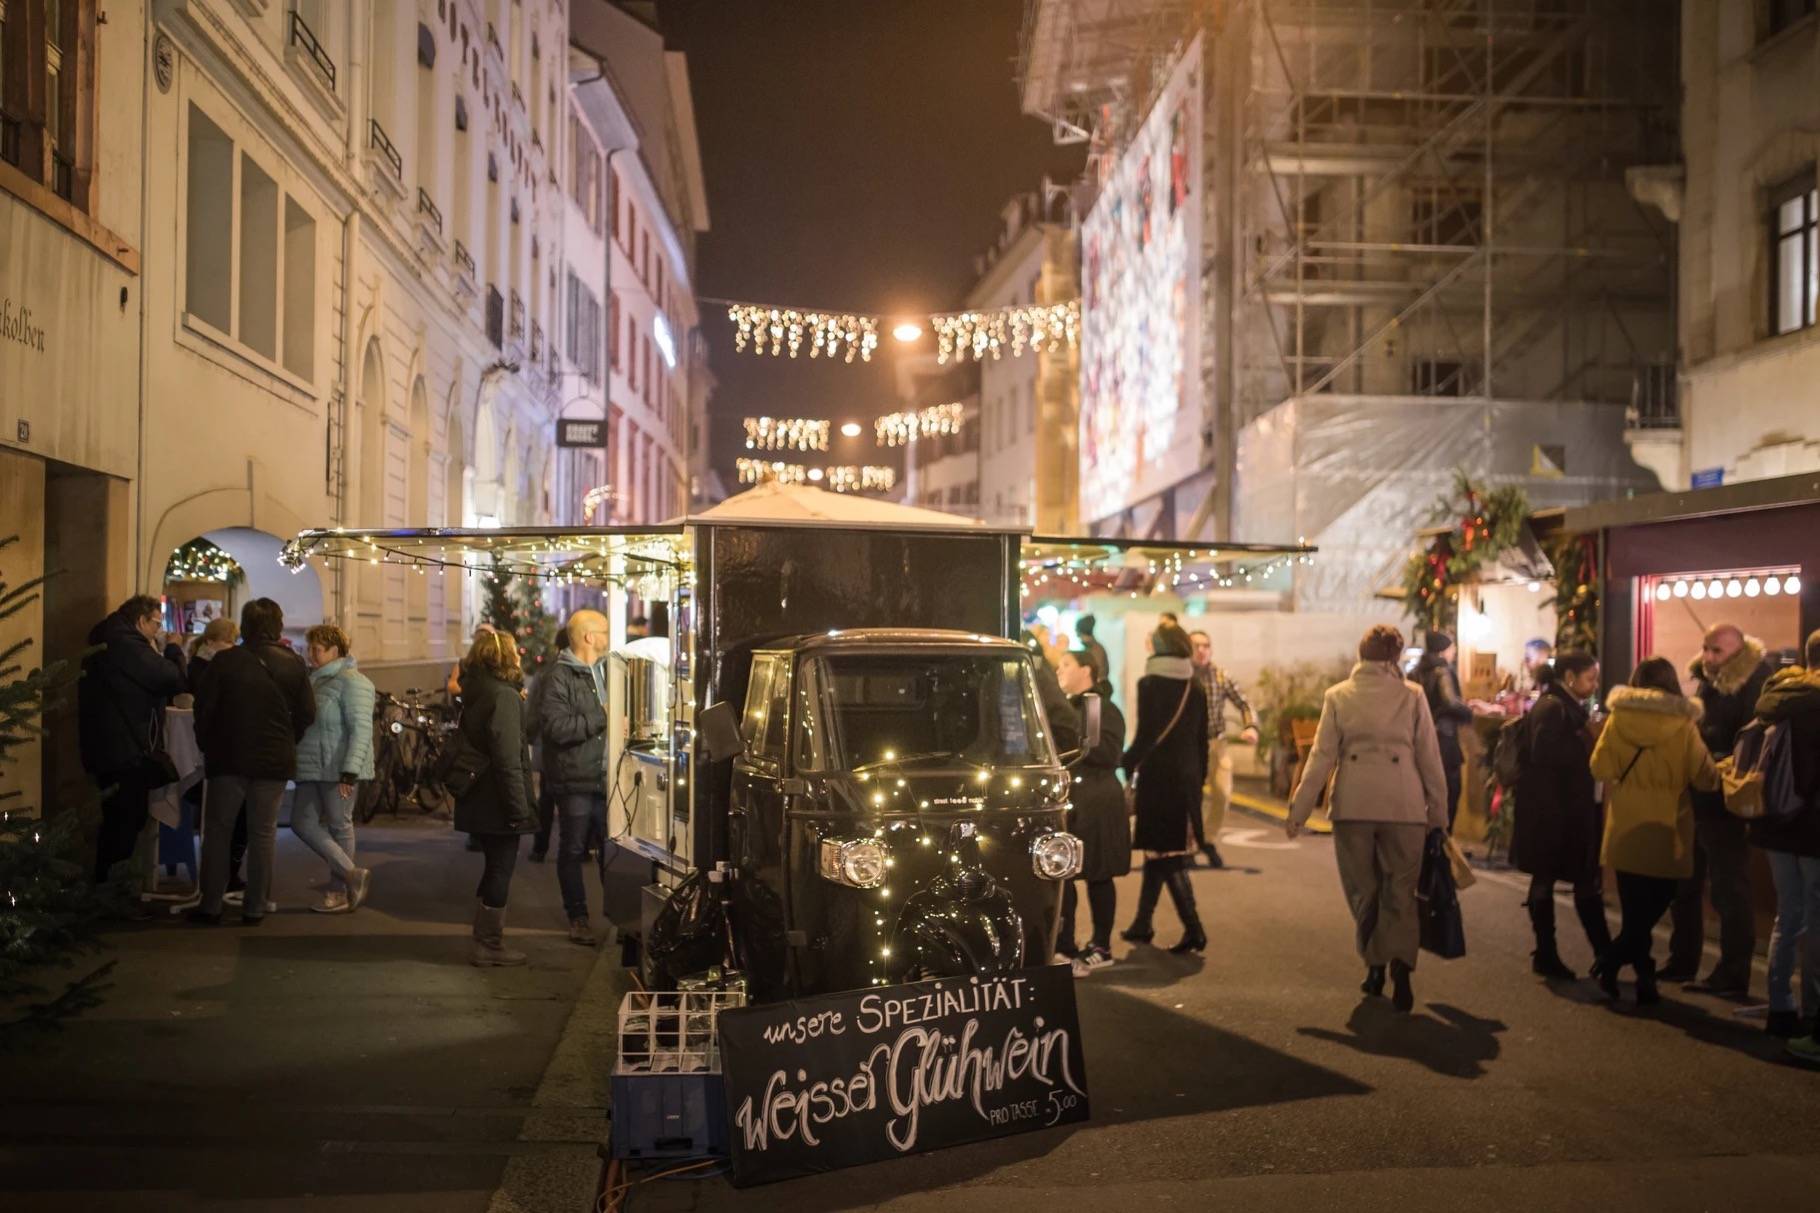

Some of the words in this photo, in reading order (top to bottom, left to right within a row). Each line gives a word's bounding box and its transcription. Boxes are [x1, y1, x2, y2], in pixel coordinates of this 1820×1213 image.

[763, 1011, 846, 1046] unsere
[886, 1016, 1088, 1152] Glühwein
[989, 1106, 1009, 1127] PRO
[1009, 1100, 1040, 1121] TASSE
